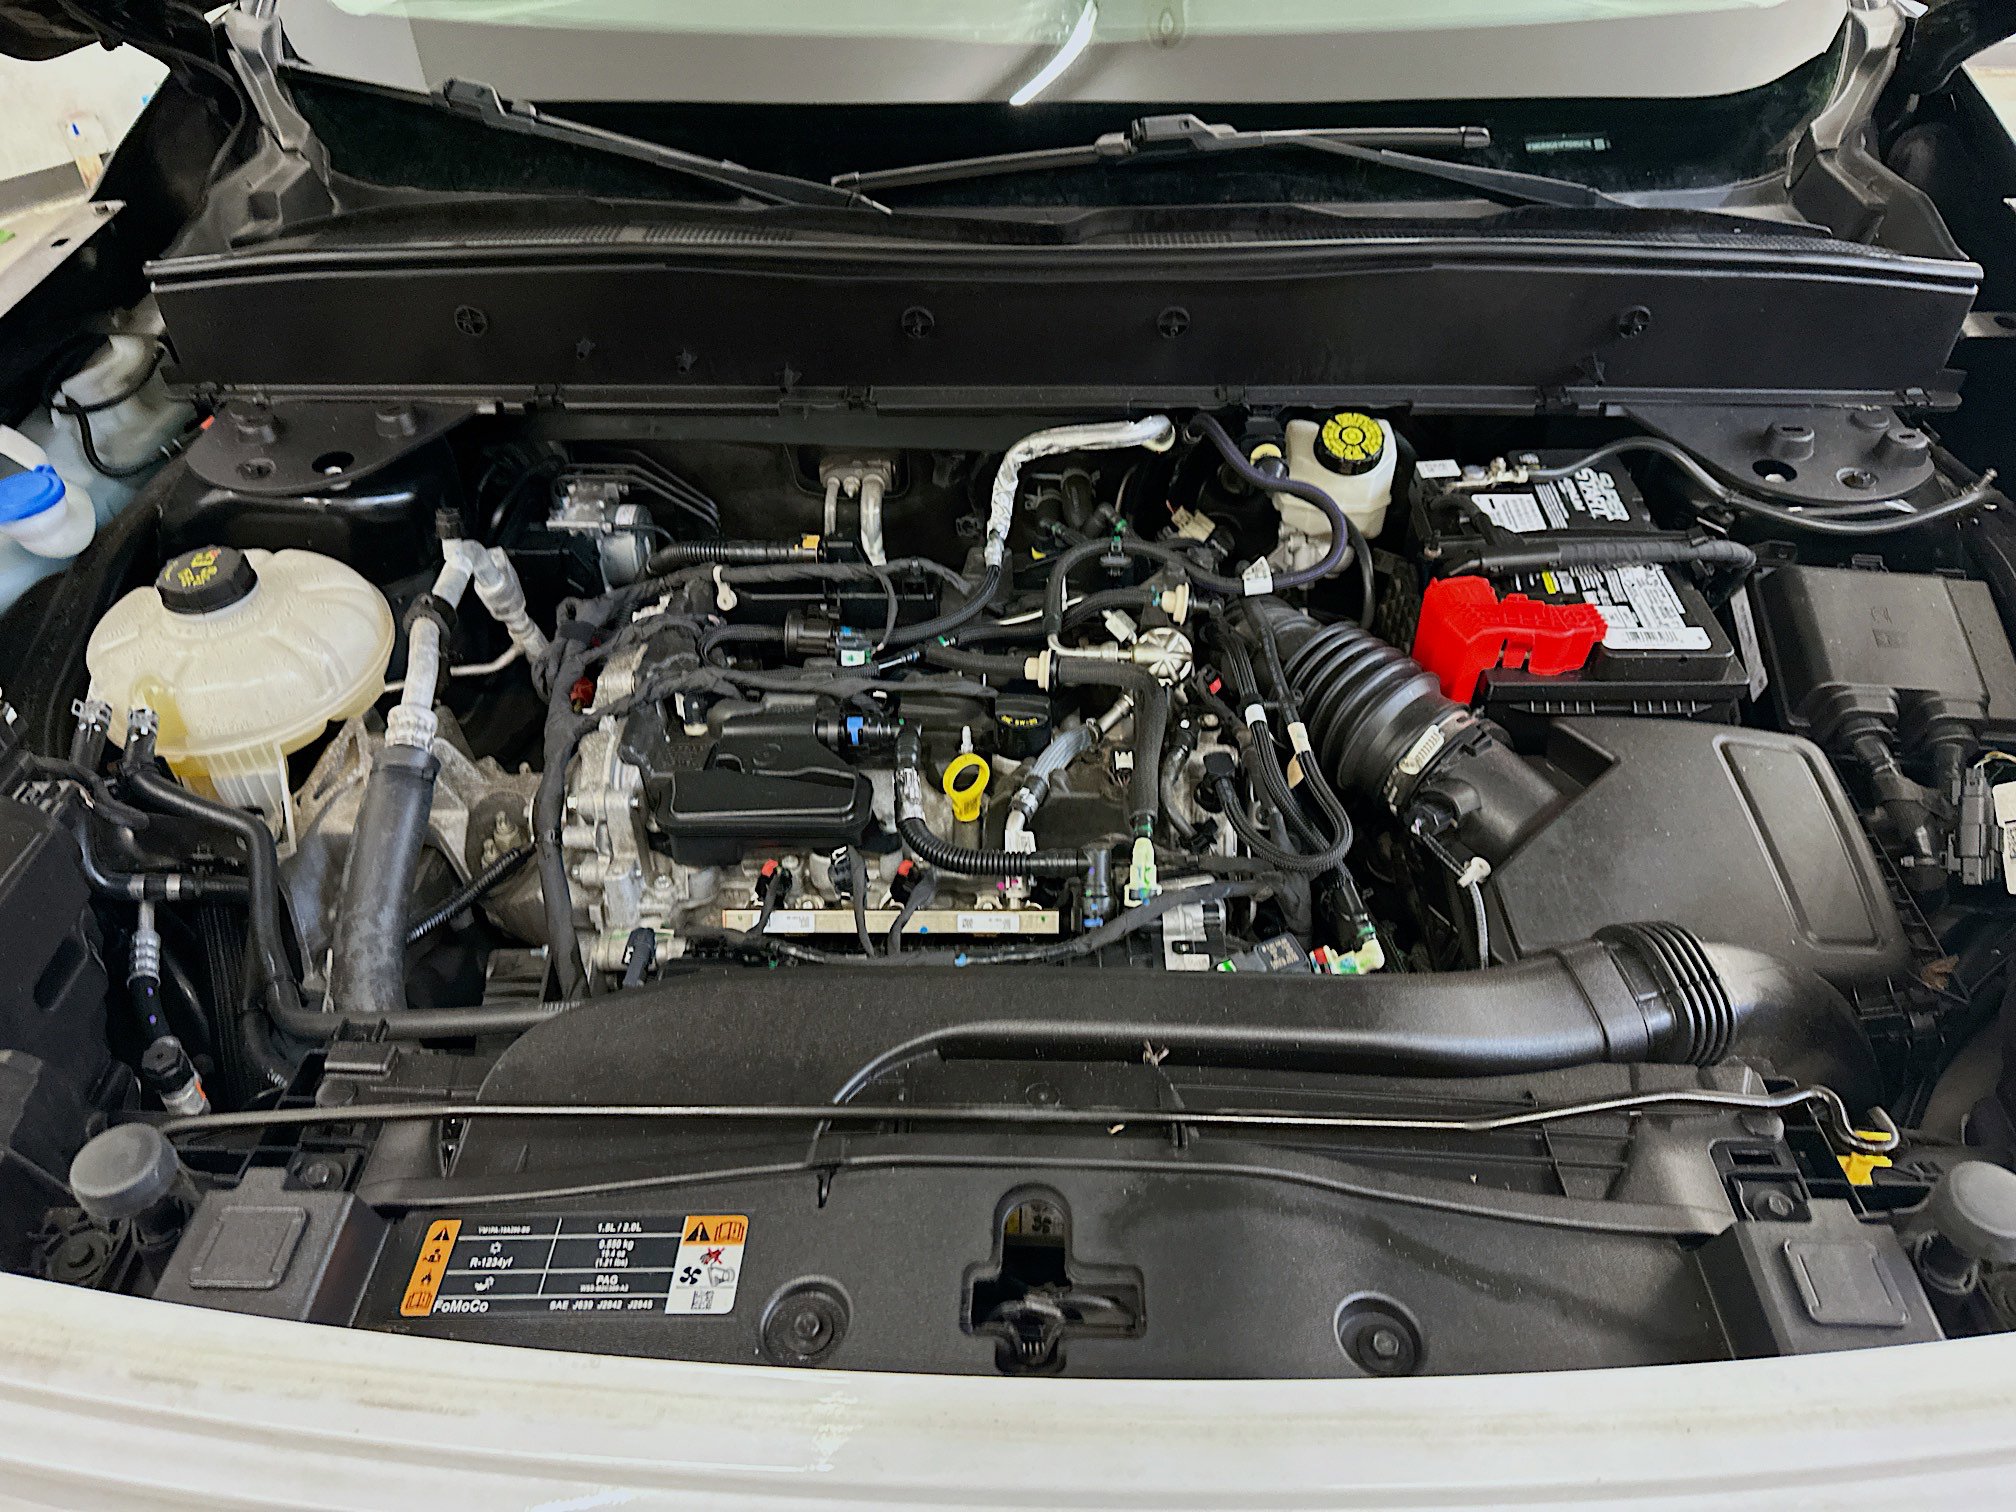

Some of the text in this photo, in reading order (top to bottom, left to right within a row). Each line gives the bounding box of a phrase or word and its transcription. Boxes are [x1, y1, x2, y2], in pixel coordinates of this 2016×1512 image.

[622, 1221, 642, 1233] 2.0L
[432, 1299, 489, 1313] FoMoCo
[549, 1299, 570, 1310] SAE
